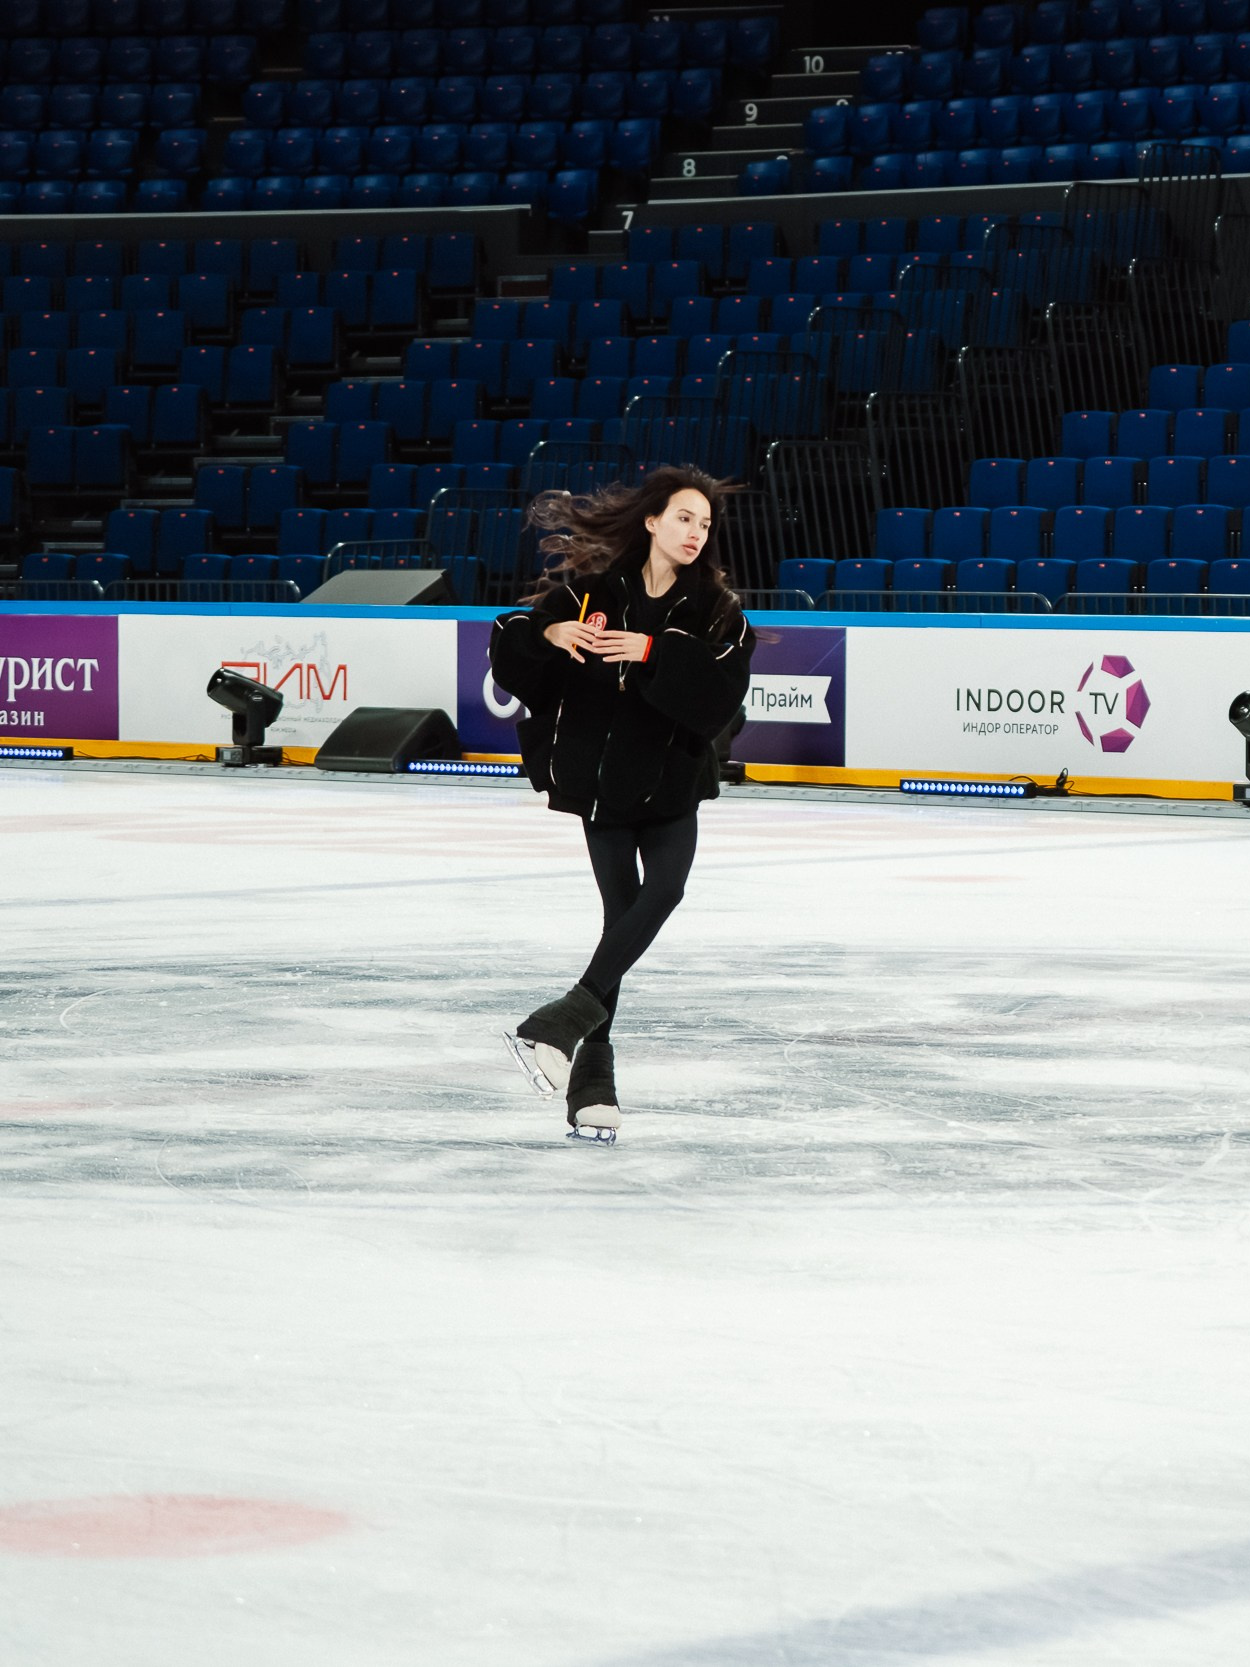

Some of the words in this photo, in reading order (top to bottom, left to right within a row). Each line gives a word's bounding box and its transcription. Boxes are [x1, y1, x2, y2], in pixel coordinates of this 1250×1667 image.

[803, 55, 824, 74] 10
[745, 103, 758, 122] 9
[682, 158, 696, 177] 8
[621, 211, 634, 231] 7
[751, 686, 812, 712] Прайм
[956, 687, 1065, 714] INDOOR
[1089, 691, 1119, 715] TV
[962, 722, 1000, 736] ИНДОР
[1003, 722, 1059, 735] ОПЕРАТОР
